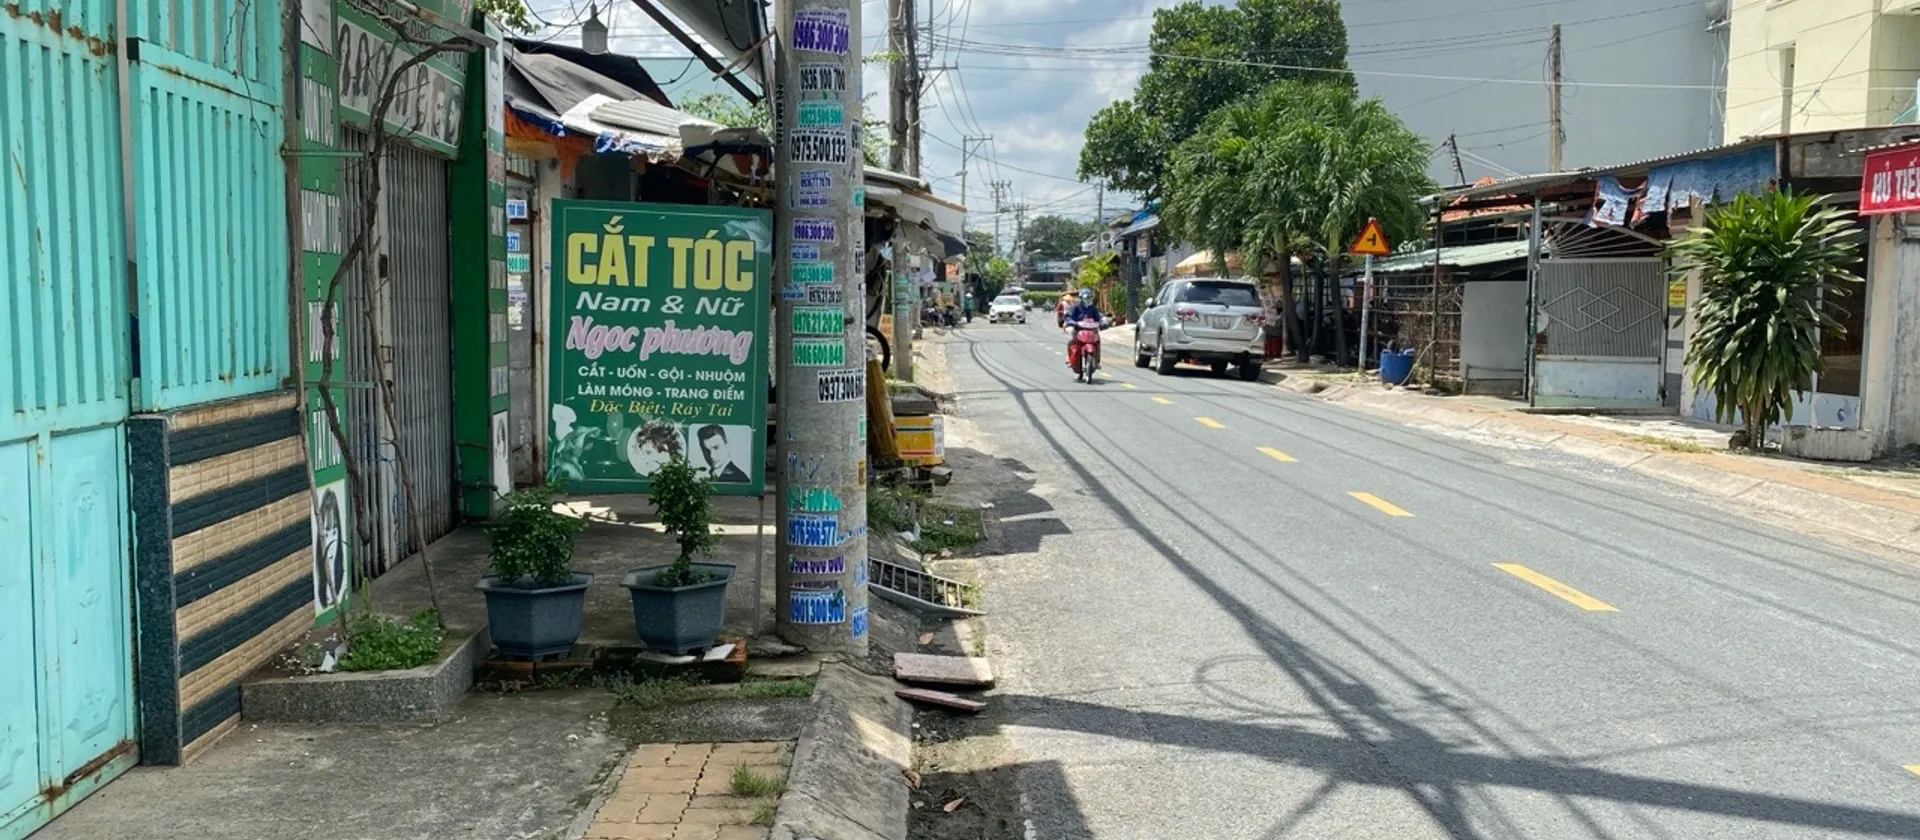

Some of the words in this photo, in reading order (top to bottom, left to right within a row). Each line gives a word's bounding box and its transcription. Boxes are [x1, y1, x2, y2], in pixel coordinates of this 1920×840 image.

[791, 135, 846, 163] 0975.500.133
[1871, 160, 1892, 203] HỦ
[567, 215, 655, 288] CẮT
[667, 229, 755, 292] TÓC
[575, 291, 650, 313] Nam
[660, 295, 684, 315] &
[695, 297, 744, 316] Nữ
[578, 361, 605, 378] CẮT
[617, 364, 646, 380] UỐN
[658, 365, 684, 385] GỘI
[695, 368, 745, 385] NHUỘM
[578, 382, 605, 396] LÀM
[609, 384, 653, 398] MÓNG
[665, 387, 709, 399] TRANG
[713, 384, 745, 401] ĐIỂM
[671, 402, 703, 418] Ráy
[708, 404, 733, 417] Tai
